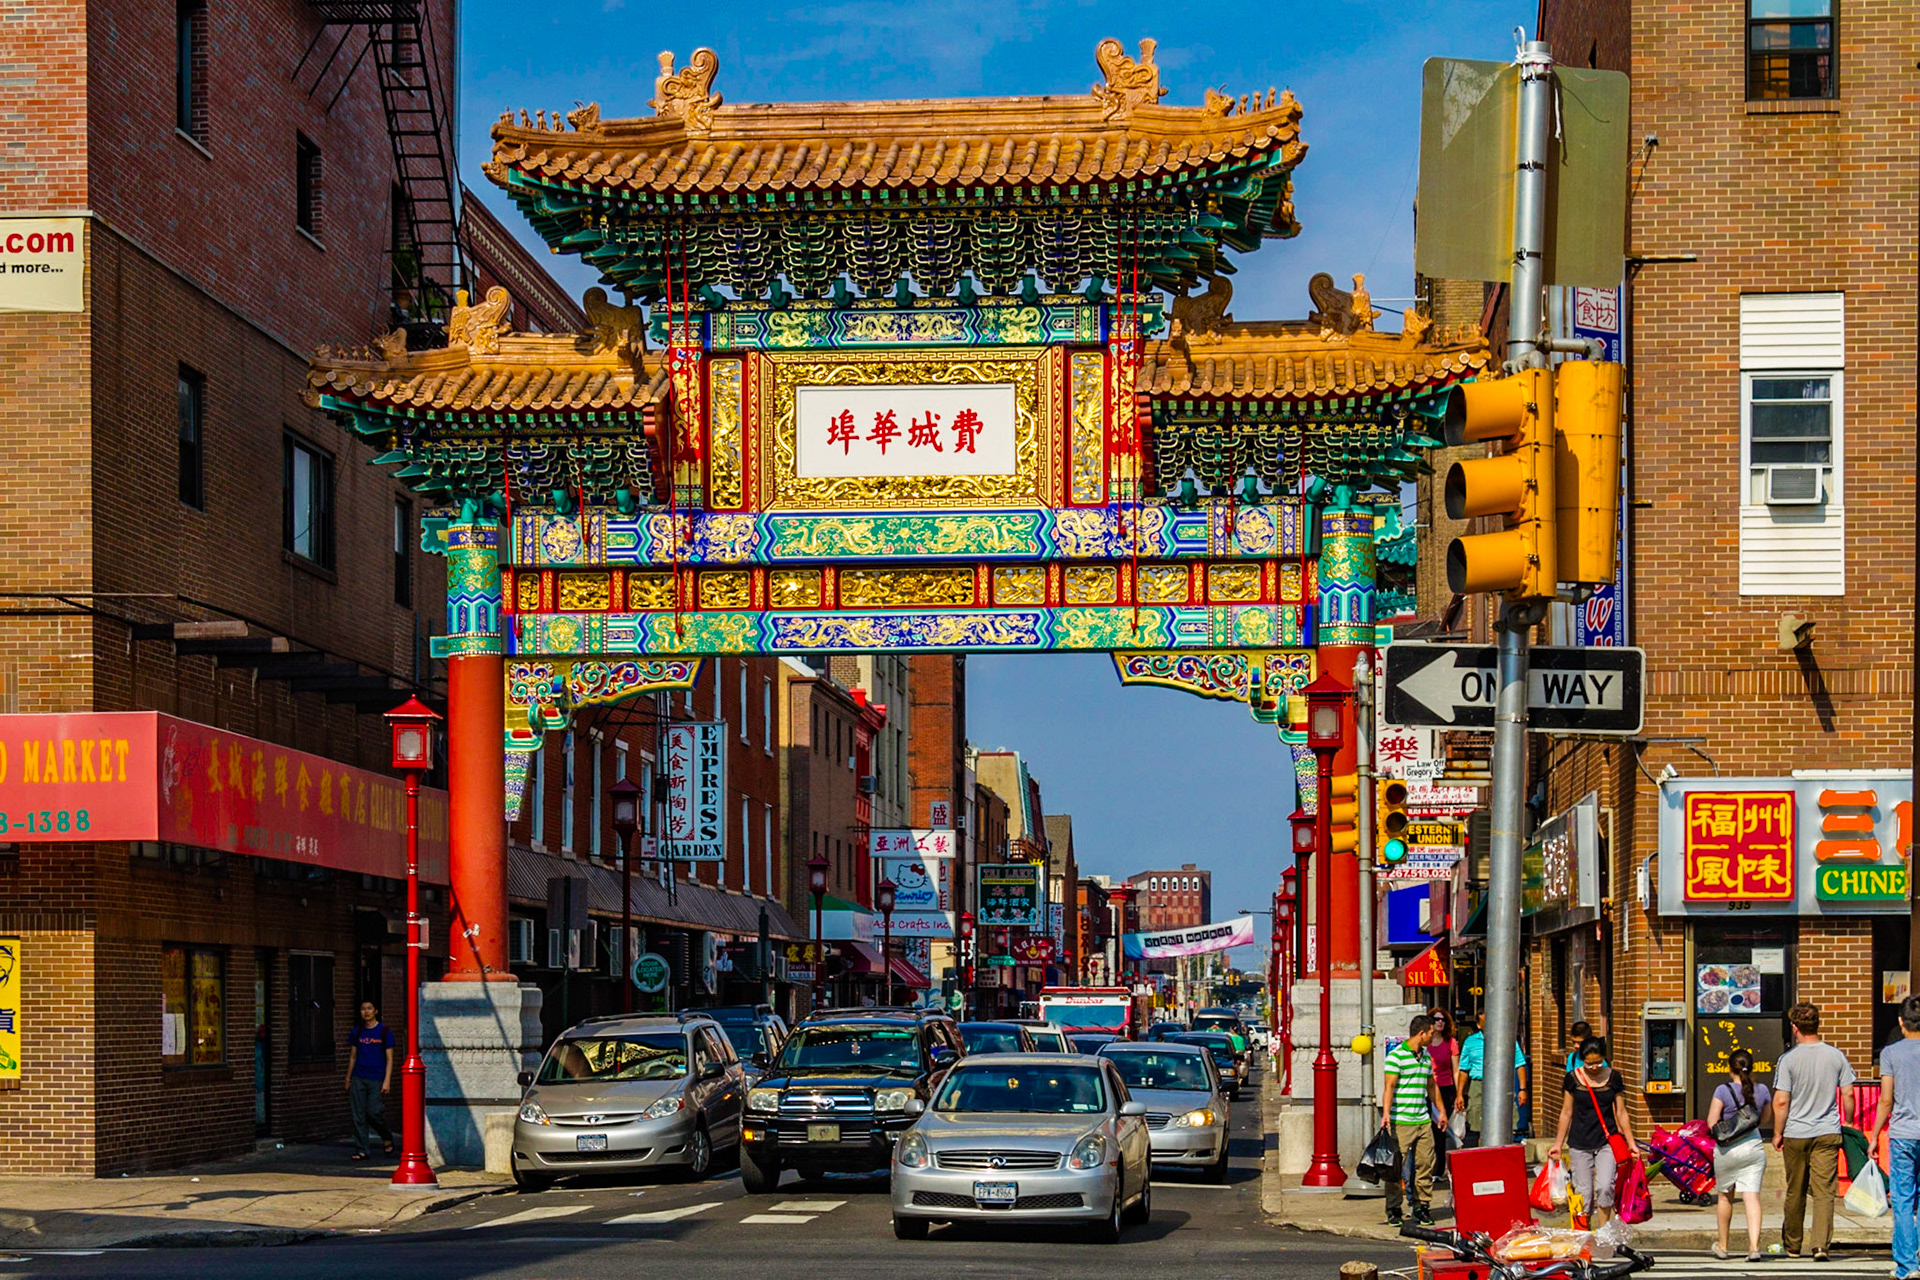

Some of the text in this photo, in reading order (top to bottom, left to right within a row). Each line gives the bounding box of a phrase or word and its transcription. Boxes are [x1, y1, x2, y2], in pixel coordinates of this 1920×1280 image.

[1461, 672, 1613, 704] ON WAY
[23, 738, 129, 783] MARKET
[1406, 768, 1433, 778] Gregory
[700, 725, 718, 841] EMPRESS
[1692, 803, 1785, 837] 福州
[1406, 825, 1452, 834] ESTERN
[1417, 834, 1452, 844] UNION
[660, 844, 723, 857] GARDEN
[1692, 854, 1787, 888] 風味
[1822, 870, 1905, 895] CHINE
[1728, 901, 1751, 910] 935
[873, 920, 895, 930] Asa
[898, 917, 931, 932] Crafts
[1408, 971, 1427, 985] SIU
